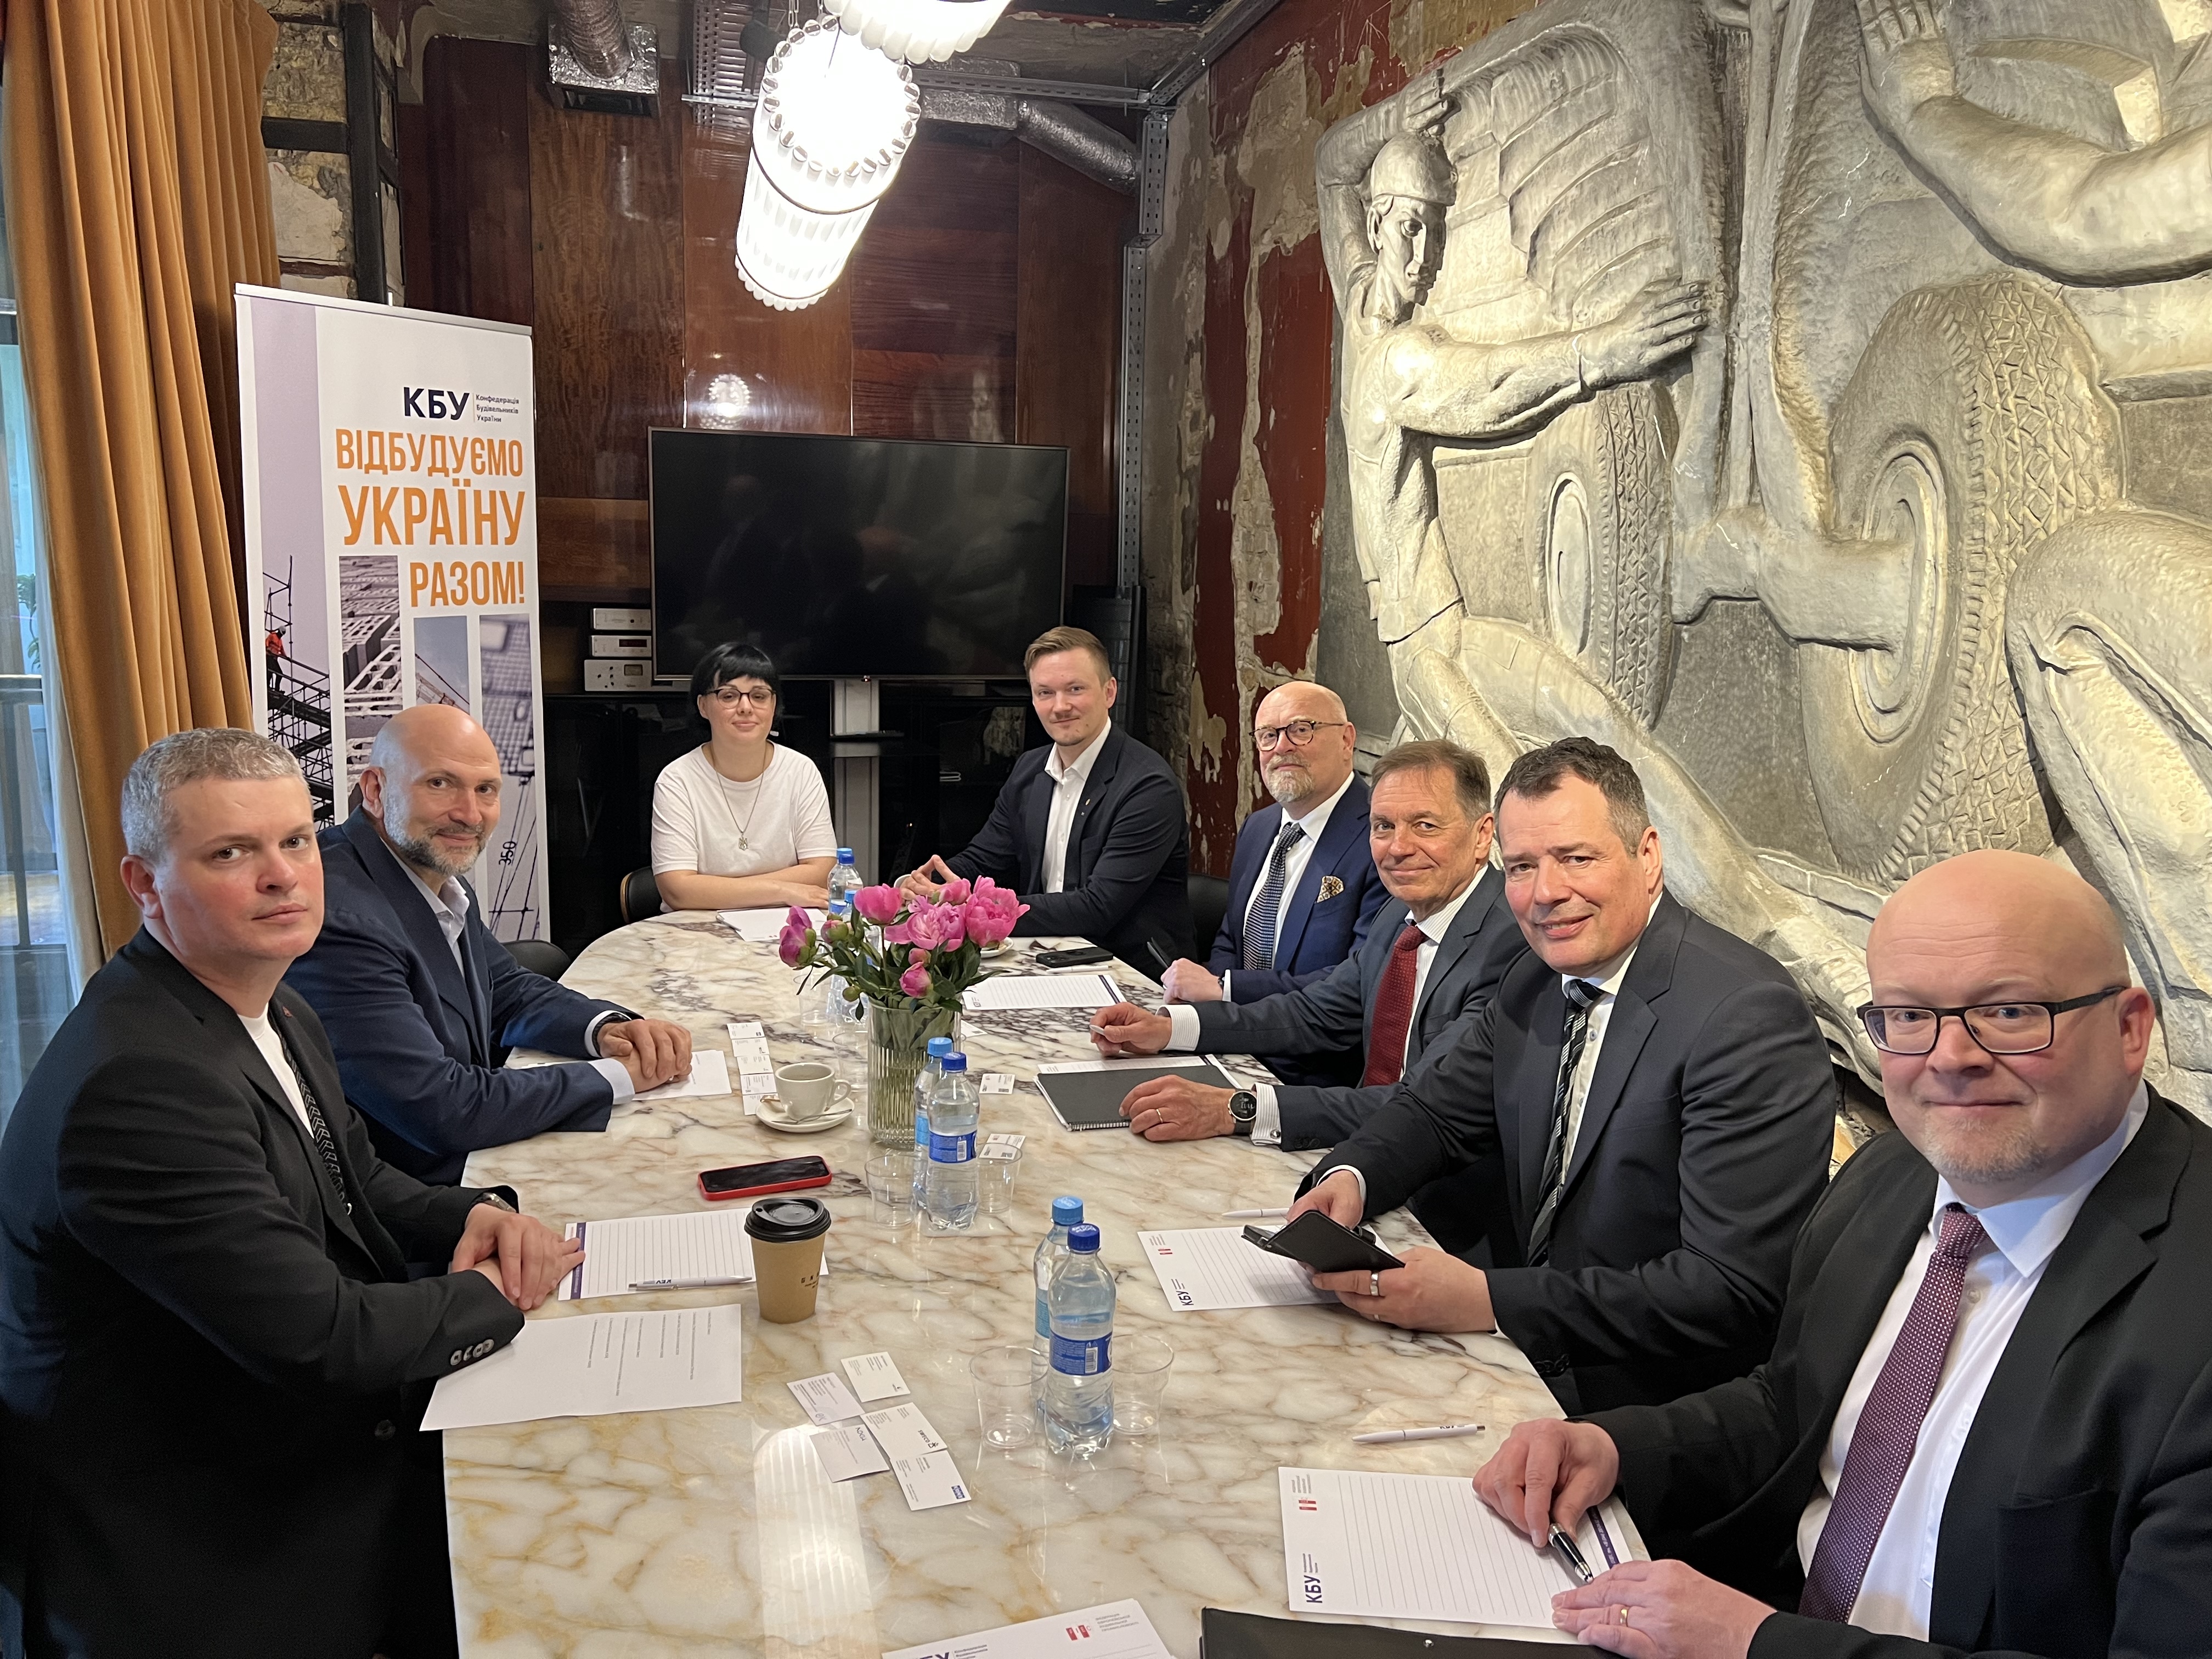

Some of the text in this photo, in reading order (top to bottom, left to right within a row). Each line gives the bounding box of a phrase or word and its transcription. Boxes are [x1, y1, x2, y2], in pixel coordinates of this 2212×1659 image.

[403, 386, 470, 420] КБУ
[476, 394, 519, 404] Конфедерація
[476, 404, 518, 414] Будівельників
[477, 414, 501, 422] України
[335, 428, 523, 477] ВІДБУДУЄМО
[337, 478, 526, 546] УКРАЇНУ
[410, 561, 526, 608] РАЗОМ!
[1177, 1290, 1194, 1306] КБУ
[1305, 1575, 1323, 1604] КБУ
